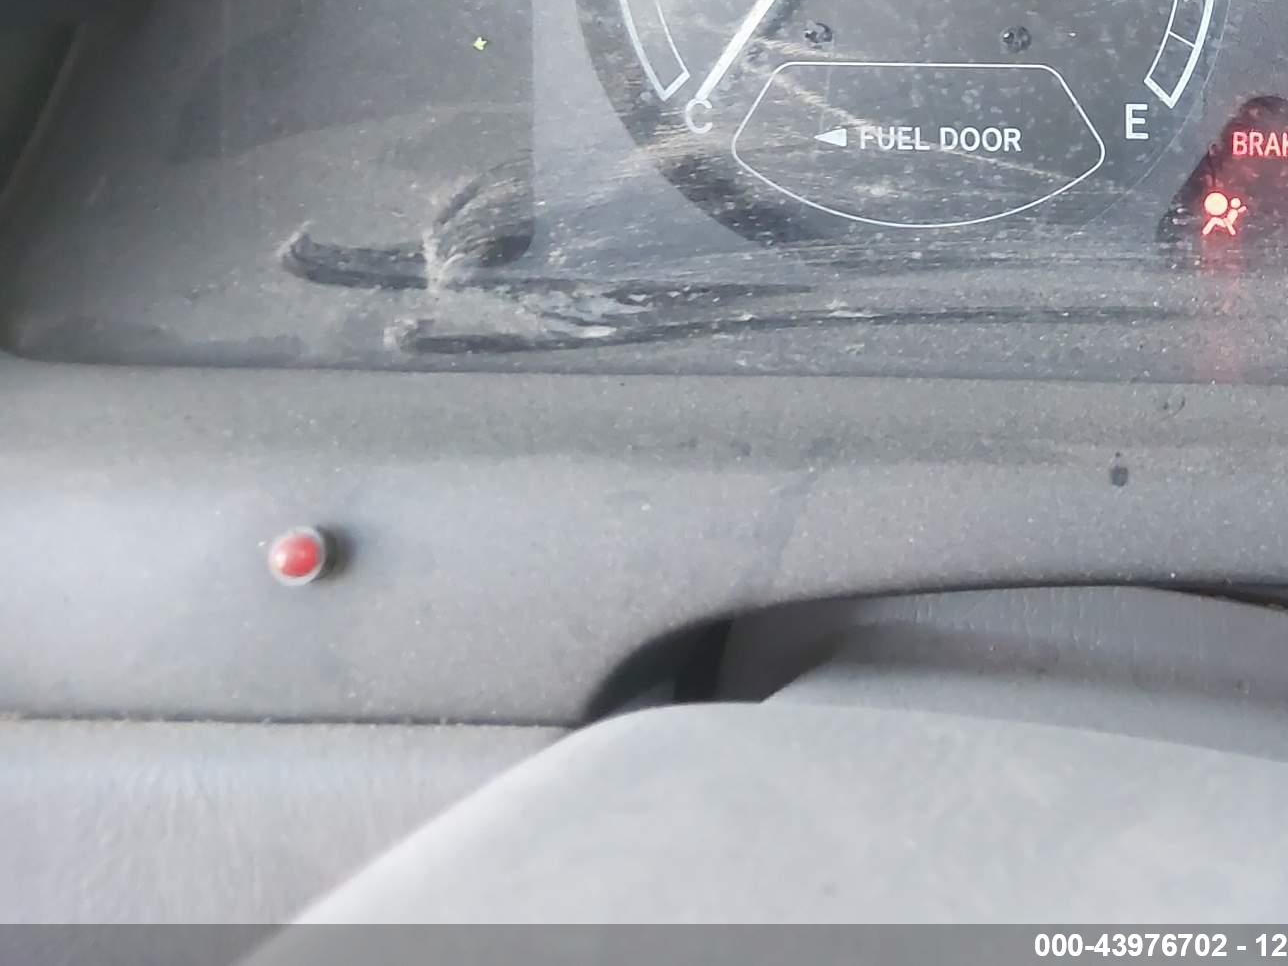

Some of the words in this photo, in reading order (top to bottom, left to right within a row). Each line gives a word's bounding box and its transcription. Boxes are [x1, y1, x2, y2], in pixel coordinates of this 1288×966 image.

[684, 98, 713, 135] C
[1125, 103, 1149, 140] E
[856, 123, 931, 151] FUEL
[939, 127, 1022, 155] DOOR
